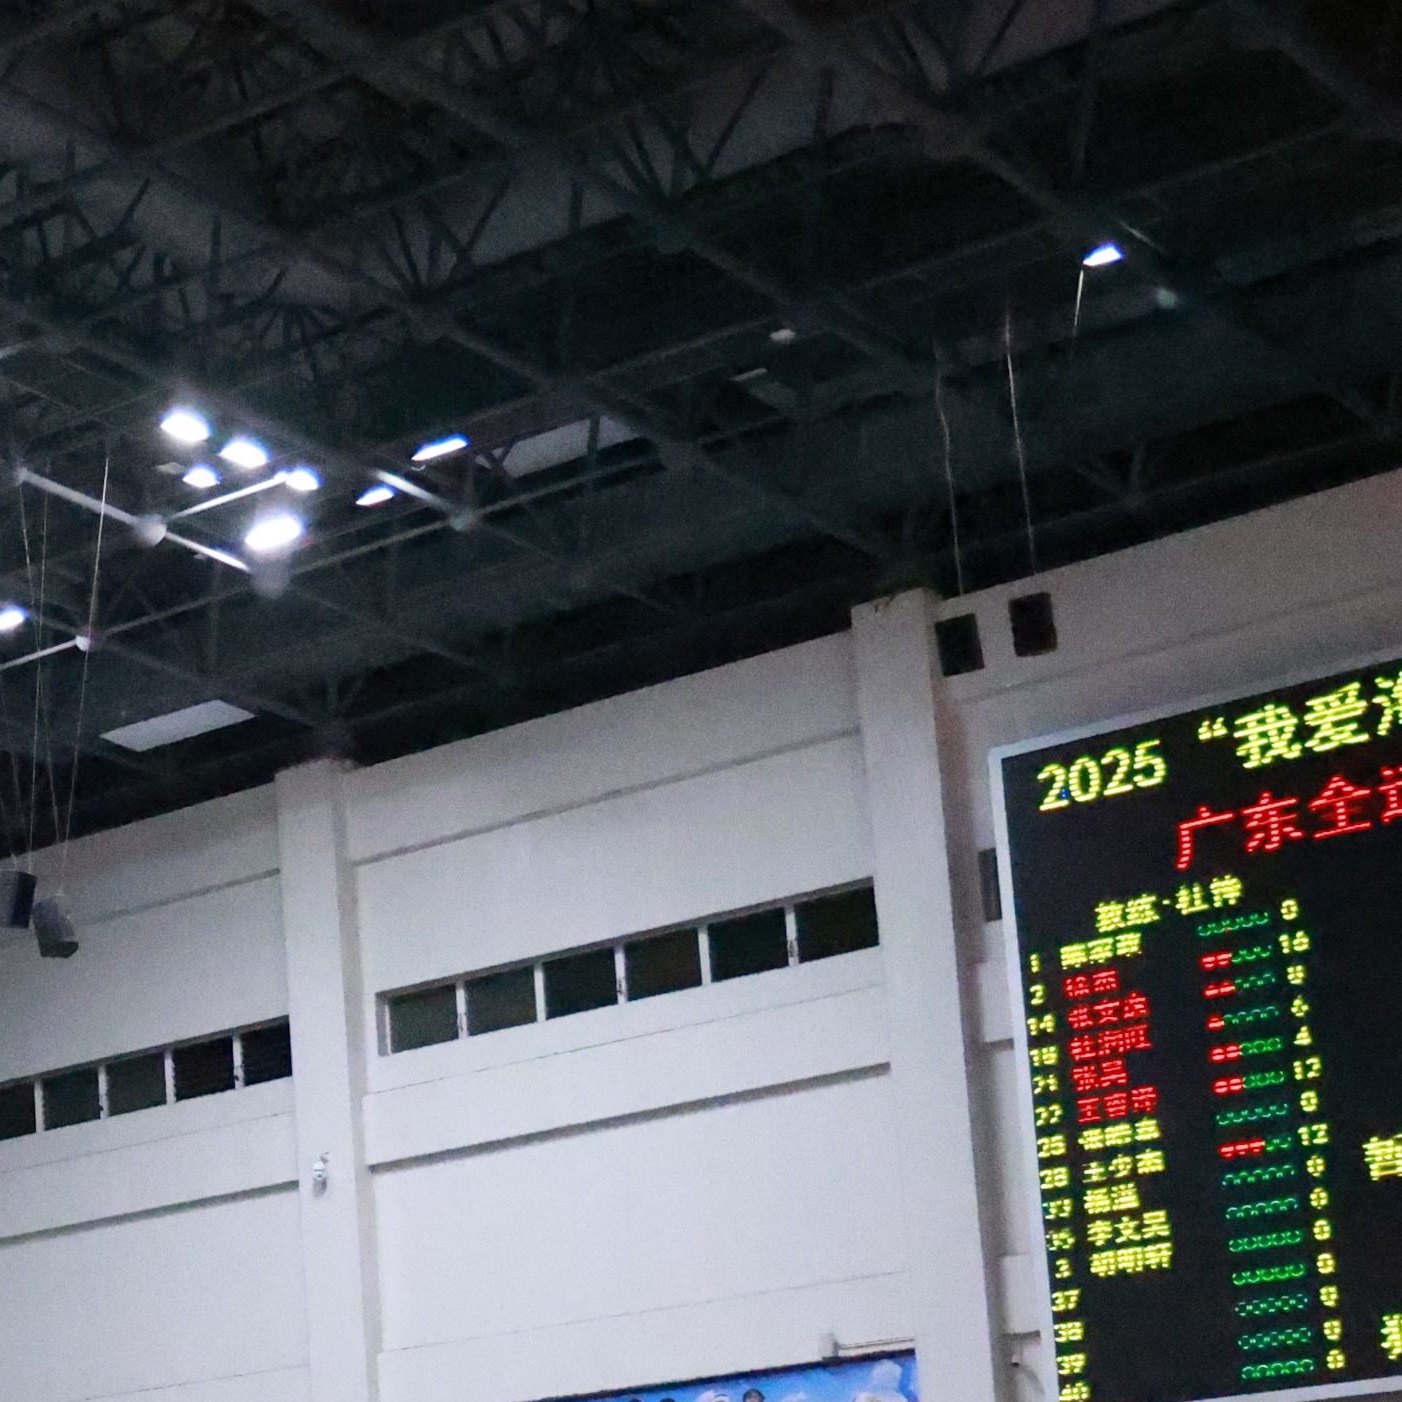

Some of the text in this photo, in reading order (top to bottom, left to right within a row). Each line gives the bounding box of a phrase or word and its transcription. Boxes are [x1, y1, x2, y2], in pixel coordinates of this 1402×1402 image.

[1037, 739, 1167, 811] 2025
[1281, 898, 1298, 920] 0
[1030, 984, 1044, 1006] 2
[1027, 1013, 1056, 1036] 14
[1037, 1134, 1065, 1158] 25
[1300, 1091, 1317, 1112] 0
